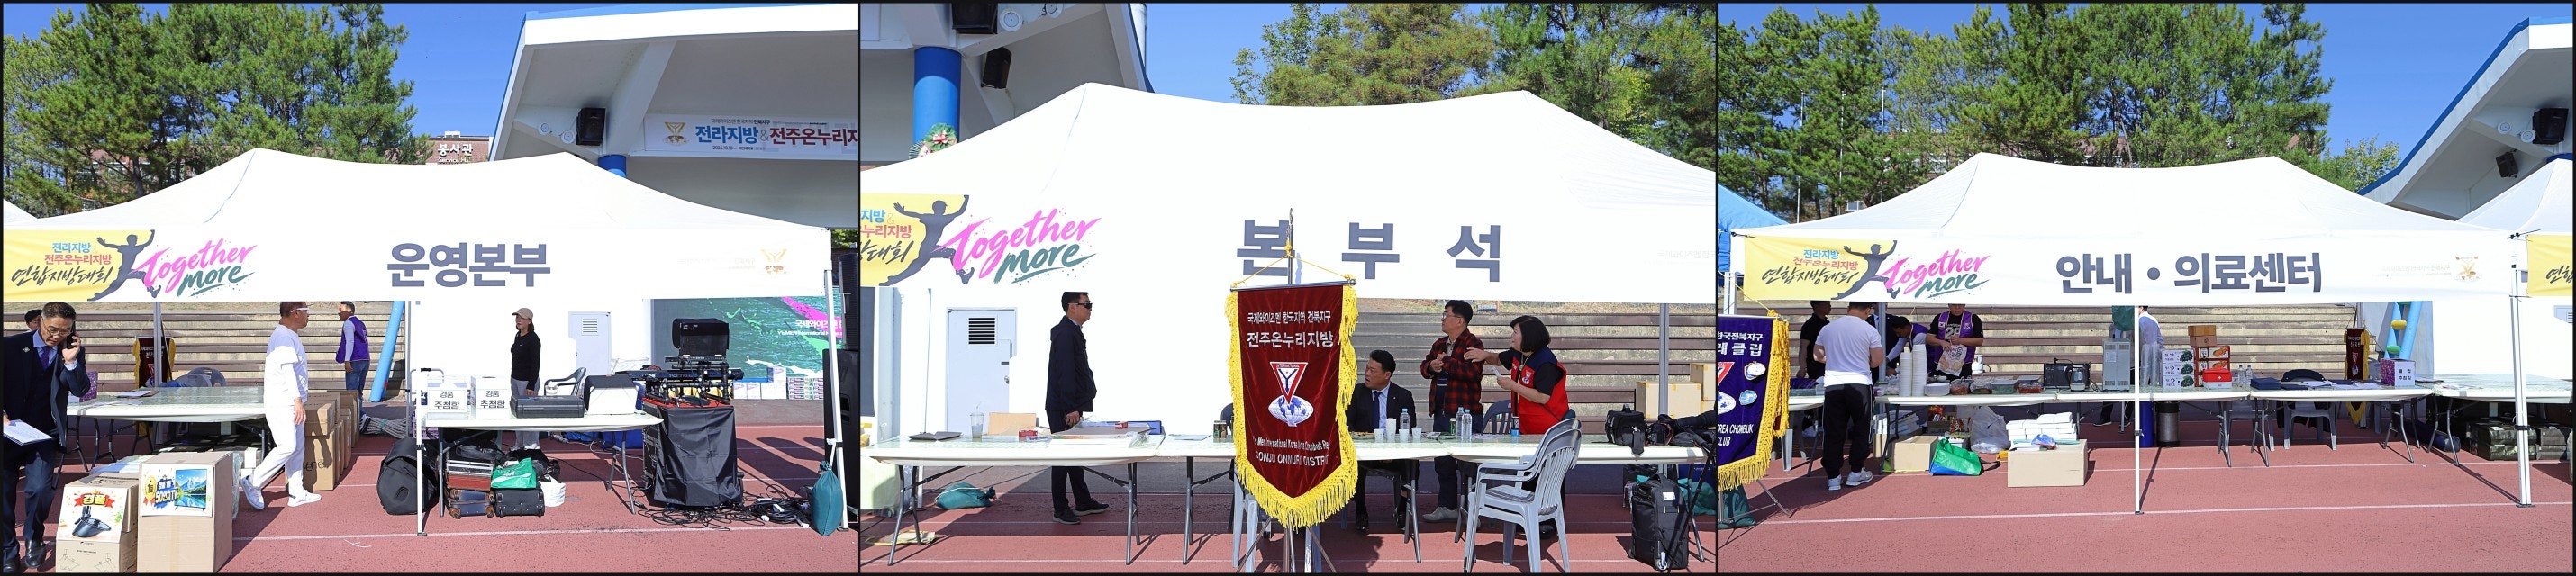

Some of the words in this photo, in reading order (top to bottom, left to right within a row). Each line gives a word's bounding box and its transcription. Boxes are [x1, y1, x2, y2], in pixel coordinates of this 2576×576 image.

[695, 126, 758, 144] 전라지방
[760, 130, 769, 142] &
[438, 144, 474, 158] 봉사관
[861, 225, 912, 238] 누리지방
[52, 243, 91, 254] 전라지방
[930, 208, 1102, 279] Together
[44, 254, 112, 265] 전주온누리지방
[1803, 249, 1839, 259] 전라지방
[128, 238, 258, 293] Together
[387, 243, 550, 287] 운영본부
[994, 245, 1098, 284] more
[1793, 257, 1859, 270] 전주온누리지방
[1873, 248, 1991, 295] Together
[2056, 253, 2132, 293] 안내
[2174, 252, 2321, 293] 의료센터
[11, 265, 113, 286] 연합지방대회
[177, 265, 256, 297] more
[1762, 266, 1859, 284] 연합지방대회
[1914, 272, 1991, 299] more
[1247, 311, 1281, 324] 국제와이즈멘
[1283, 311, 1306, 324] 한국지역
[1308, 310, 1331, 324] 전북지구
[1247, 331, 1333, 347] 전주온누리지방
[434, 400, 459, 409] 추첨함
[481, 400, 505, 409] 추첨함
